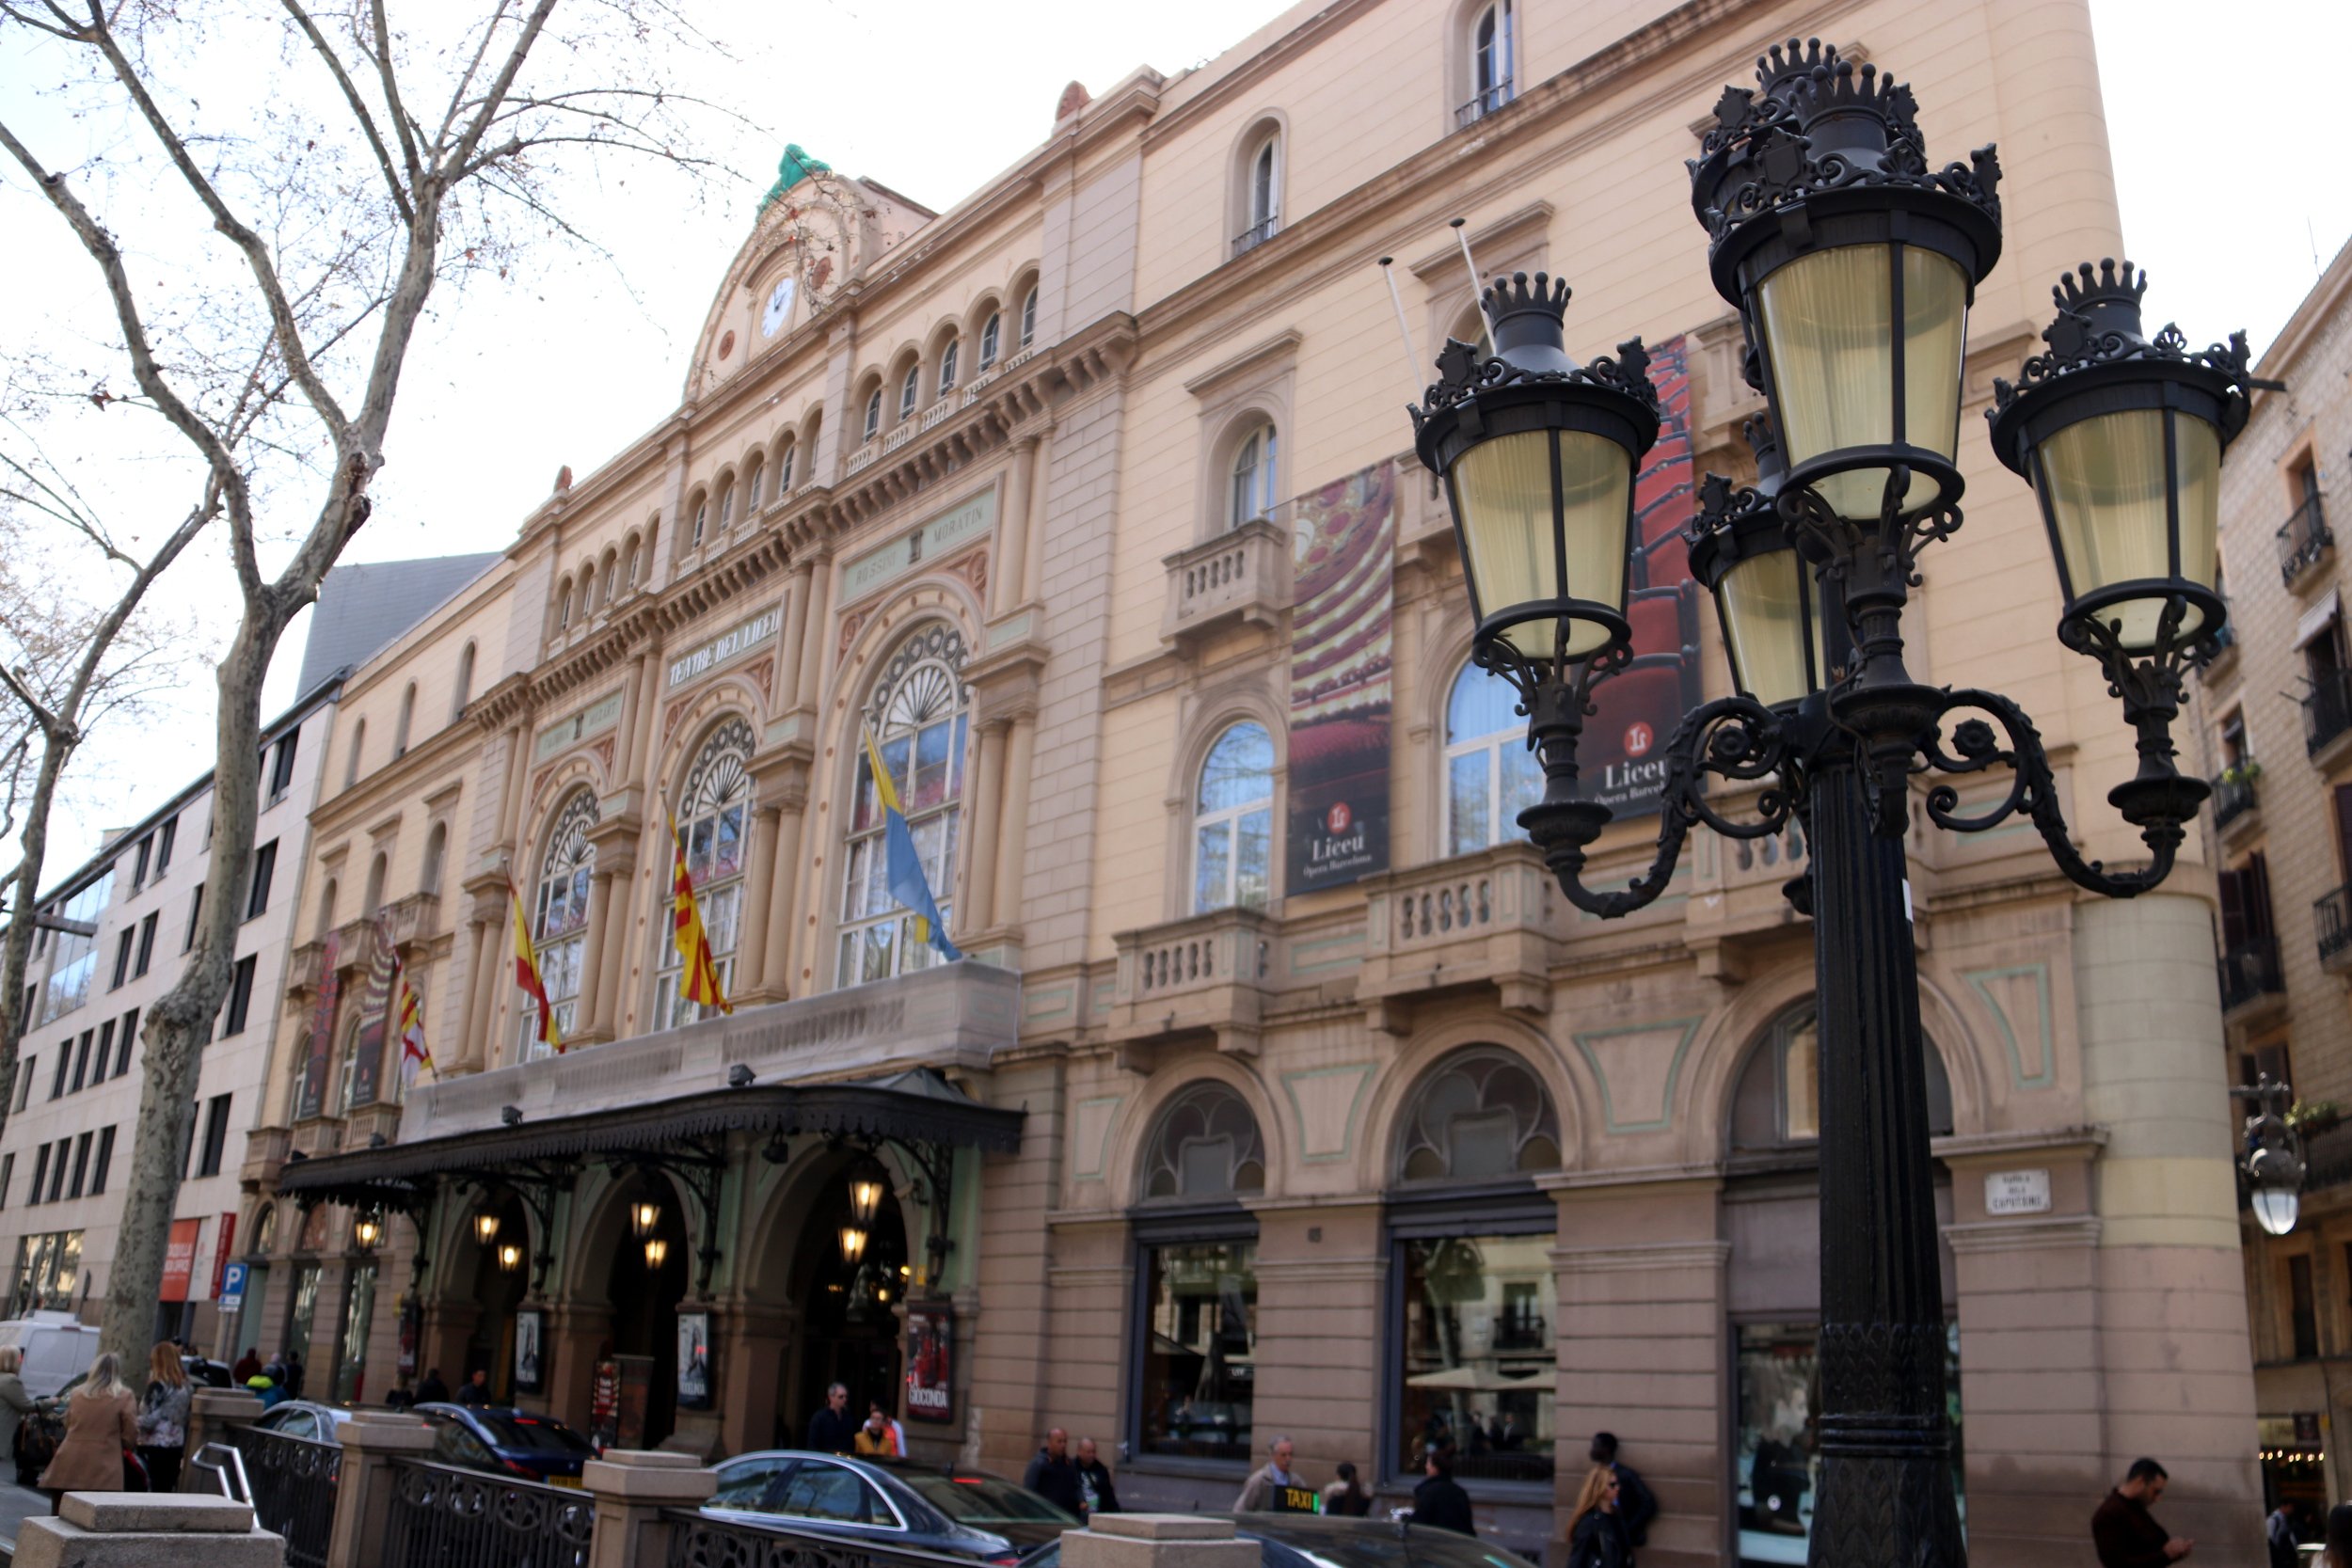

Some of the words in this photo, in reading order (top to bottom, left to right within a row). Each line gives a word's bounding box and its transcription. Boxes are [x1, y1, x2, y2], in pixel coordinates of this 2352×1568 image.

[855, 549, 897, 586] ROSSINI
[933, 505, 984, 543] MORATIN
[669, 643, 713, 687] TEATRE
[715, 631, 739, 663] DEL
[743, 607, 782, 649] LICEU
[1605, 758, 1666, 790] Liceu
[1629, 780, 1665, 800] Barcel
[1312, 834, 1364, 862] Liceu
[1329, 854, 1373, 871] Barcelona
[225, 1266, 242, 1291] P
[909, 1387, 947, 1409] GIOCONDA
[1285, 1487, 1312, 1511] TAXI
